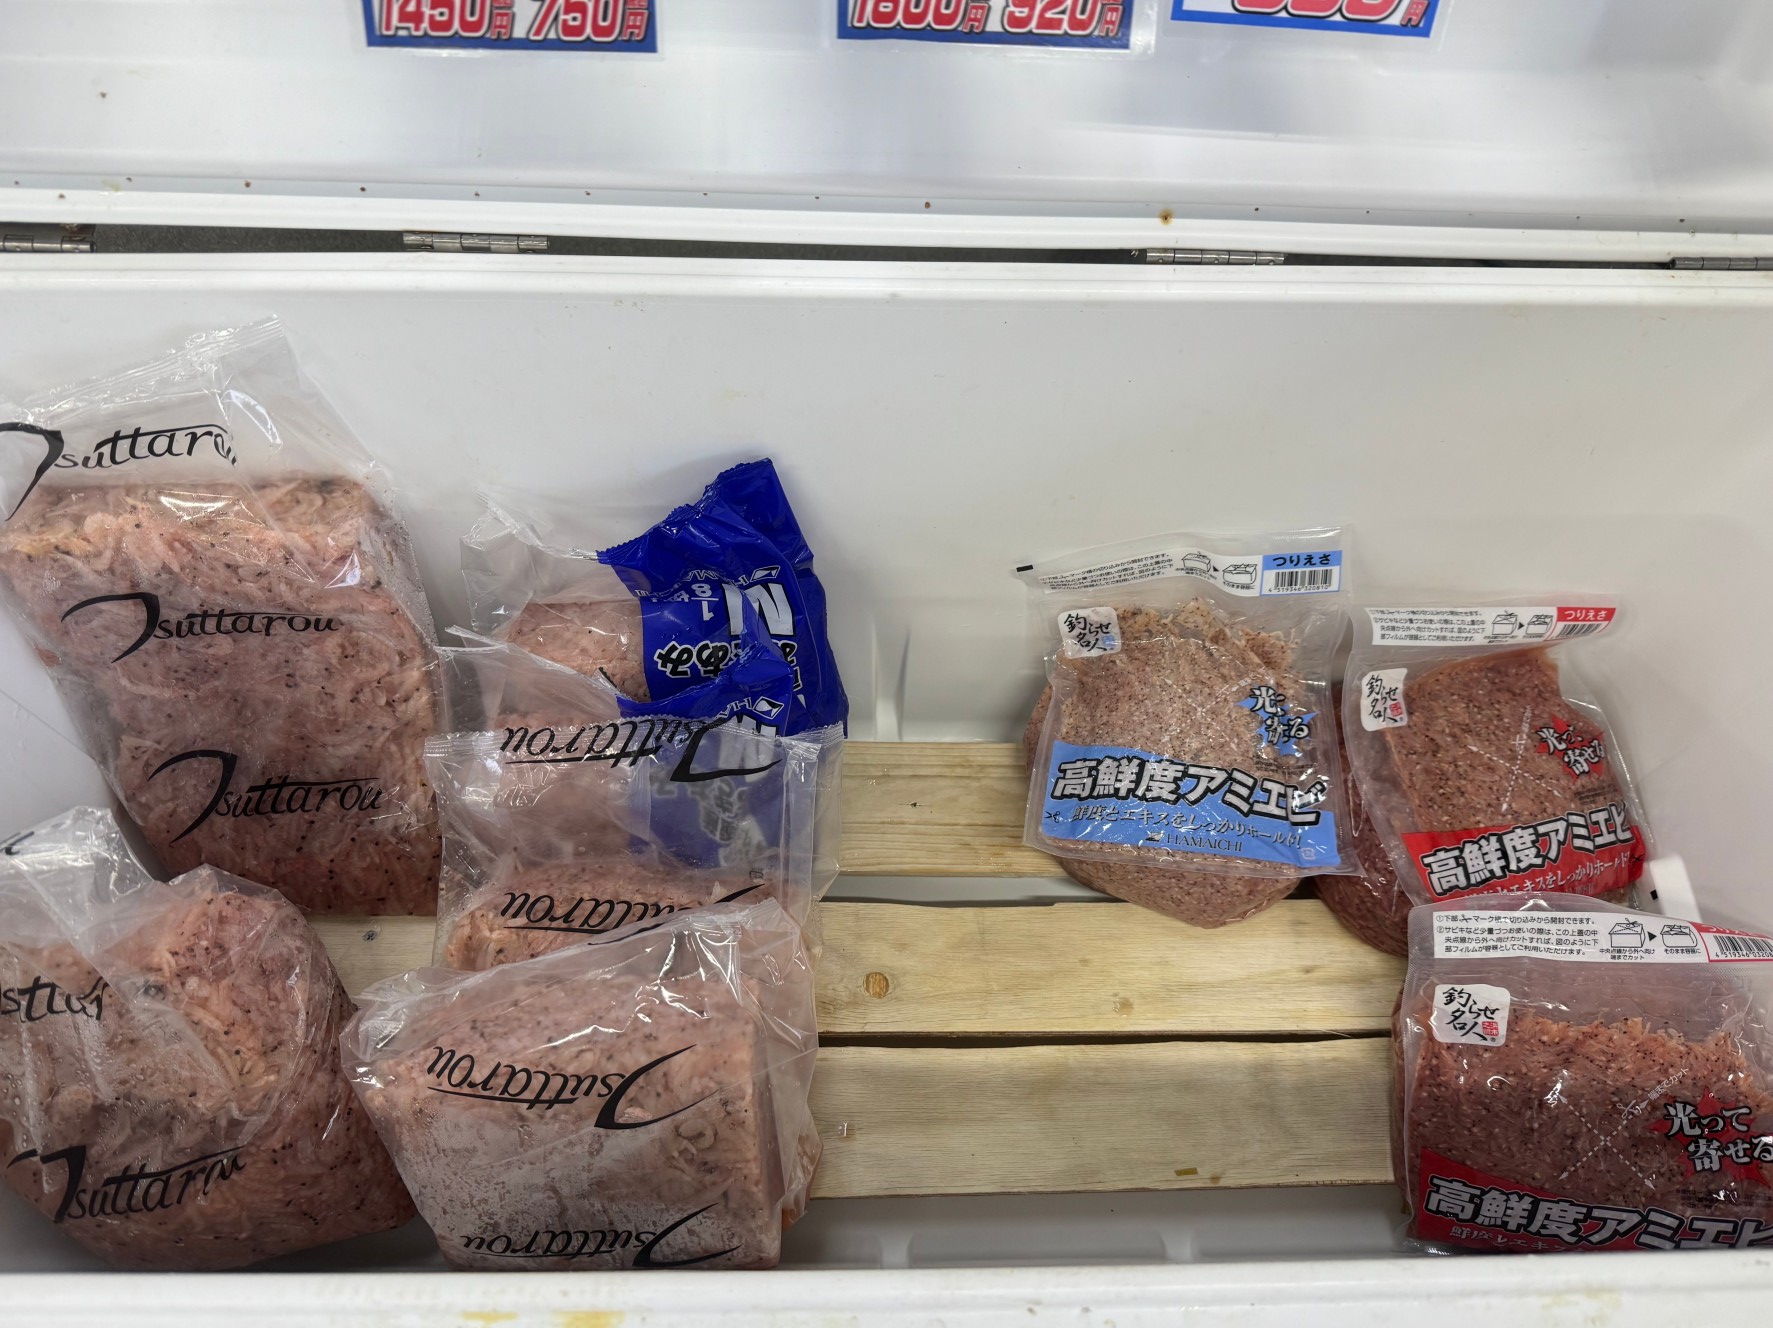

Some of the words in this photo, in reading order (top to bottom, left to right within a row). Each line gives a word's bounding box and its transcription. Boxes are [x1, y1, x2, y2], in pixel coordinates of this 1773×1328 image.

[1273, 553, 1331, 567] つりえさ
[61, 592, 339, 664] Tsuttarou
[1564, 609, 1608, 621] つりえさ
[148, 749, 383, 843] Tsuttarou
[1050, 756, 1328, 827] 高鮮度アミエビ
[1166, 833, 1243, 852] HAMAICHI
[427, 1044, 722, 1130] Tsuttarou
[1663, 1099, 1752, 1138] 光って
[1687, 1134, 1773, 1174] 寄せる
[460, 1203, 742, 1267] Tsuttarou
